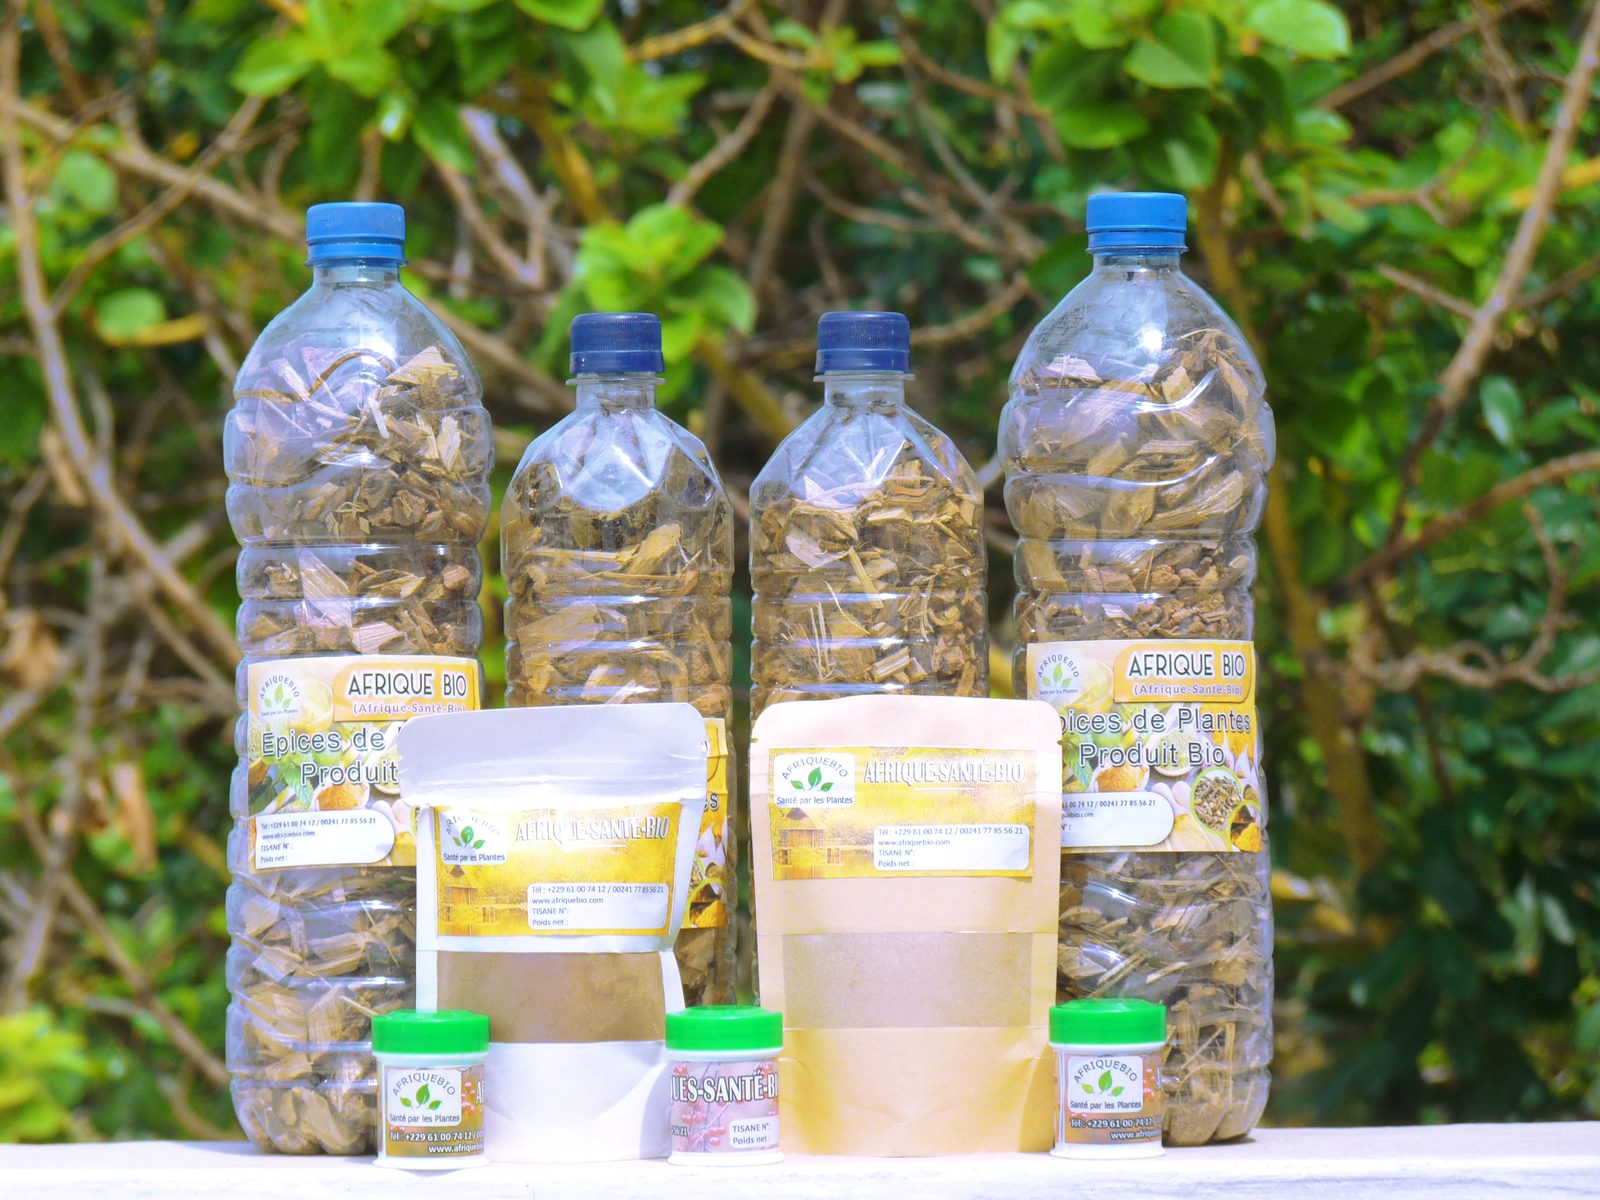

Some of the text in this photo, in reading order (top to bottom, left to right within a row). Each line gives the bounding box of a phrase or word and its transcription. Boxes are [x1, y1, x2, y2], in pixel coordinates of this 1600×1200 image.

[1128, 653, 1245, 677] AFRIQUE BIO
[348, 672, 467, 697] AFRIQUE BIO
[1060, 708, 1251, 733] pices de Plantes
[262, 727, 386, 758] Epices de
[1080, 742, 1225, 767] Produit Bio
[301, 761, 398, 785] Produit
[782, 756, 849, 780] AFRIQUEBIO
[776, 796, 798, 805] Santé
[813, 796, 825, 804] les
[826, 796, 854, 804] Plantes
[960, 827, 981, 835] 00241
[478, 853, 506, 861] Plantes
[1073, 1059, 1138, 1084] AFRIQUEBIO
[392, 1072, 456, 1096] AFRIQUEBIO
[1090, 1102, 1101, 1110] par
[1104, 1101, 1115, 1109] les
[1117, 1100, 1141, 1109] Plantes
[407, 1115, 420, 1124] par
[422, 1114, 432, 1123] les
[435, 1113, 460, 1123] Plantes
[1087, 1119, 1109, 1128] +229
[1110, 1119, 1120, 1128] 61
[1122, 1118, 1133, 1127] 00
[405, 1133, 426, 1142] +229
[427, 1132, 438, 1141] 61
[440, 1132, 451, 1141] 00
[453, 1132, 462, 1141] 74
[732, 1124, 760, 1133] TISANE
[756, 1135, 767, 1143] net
